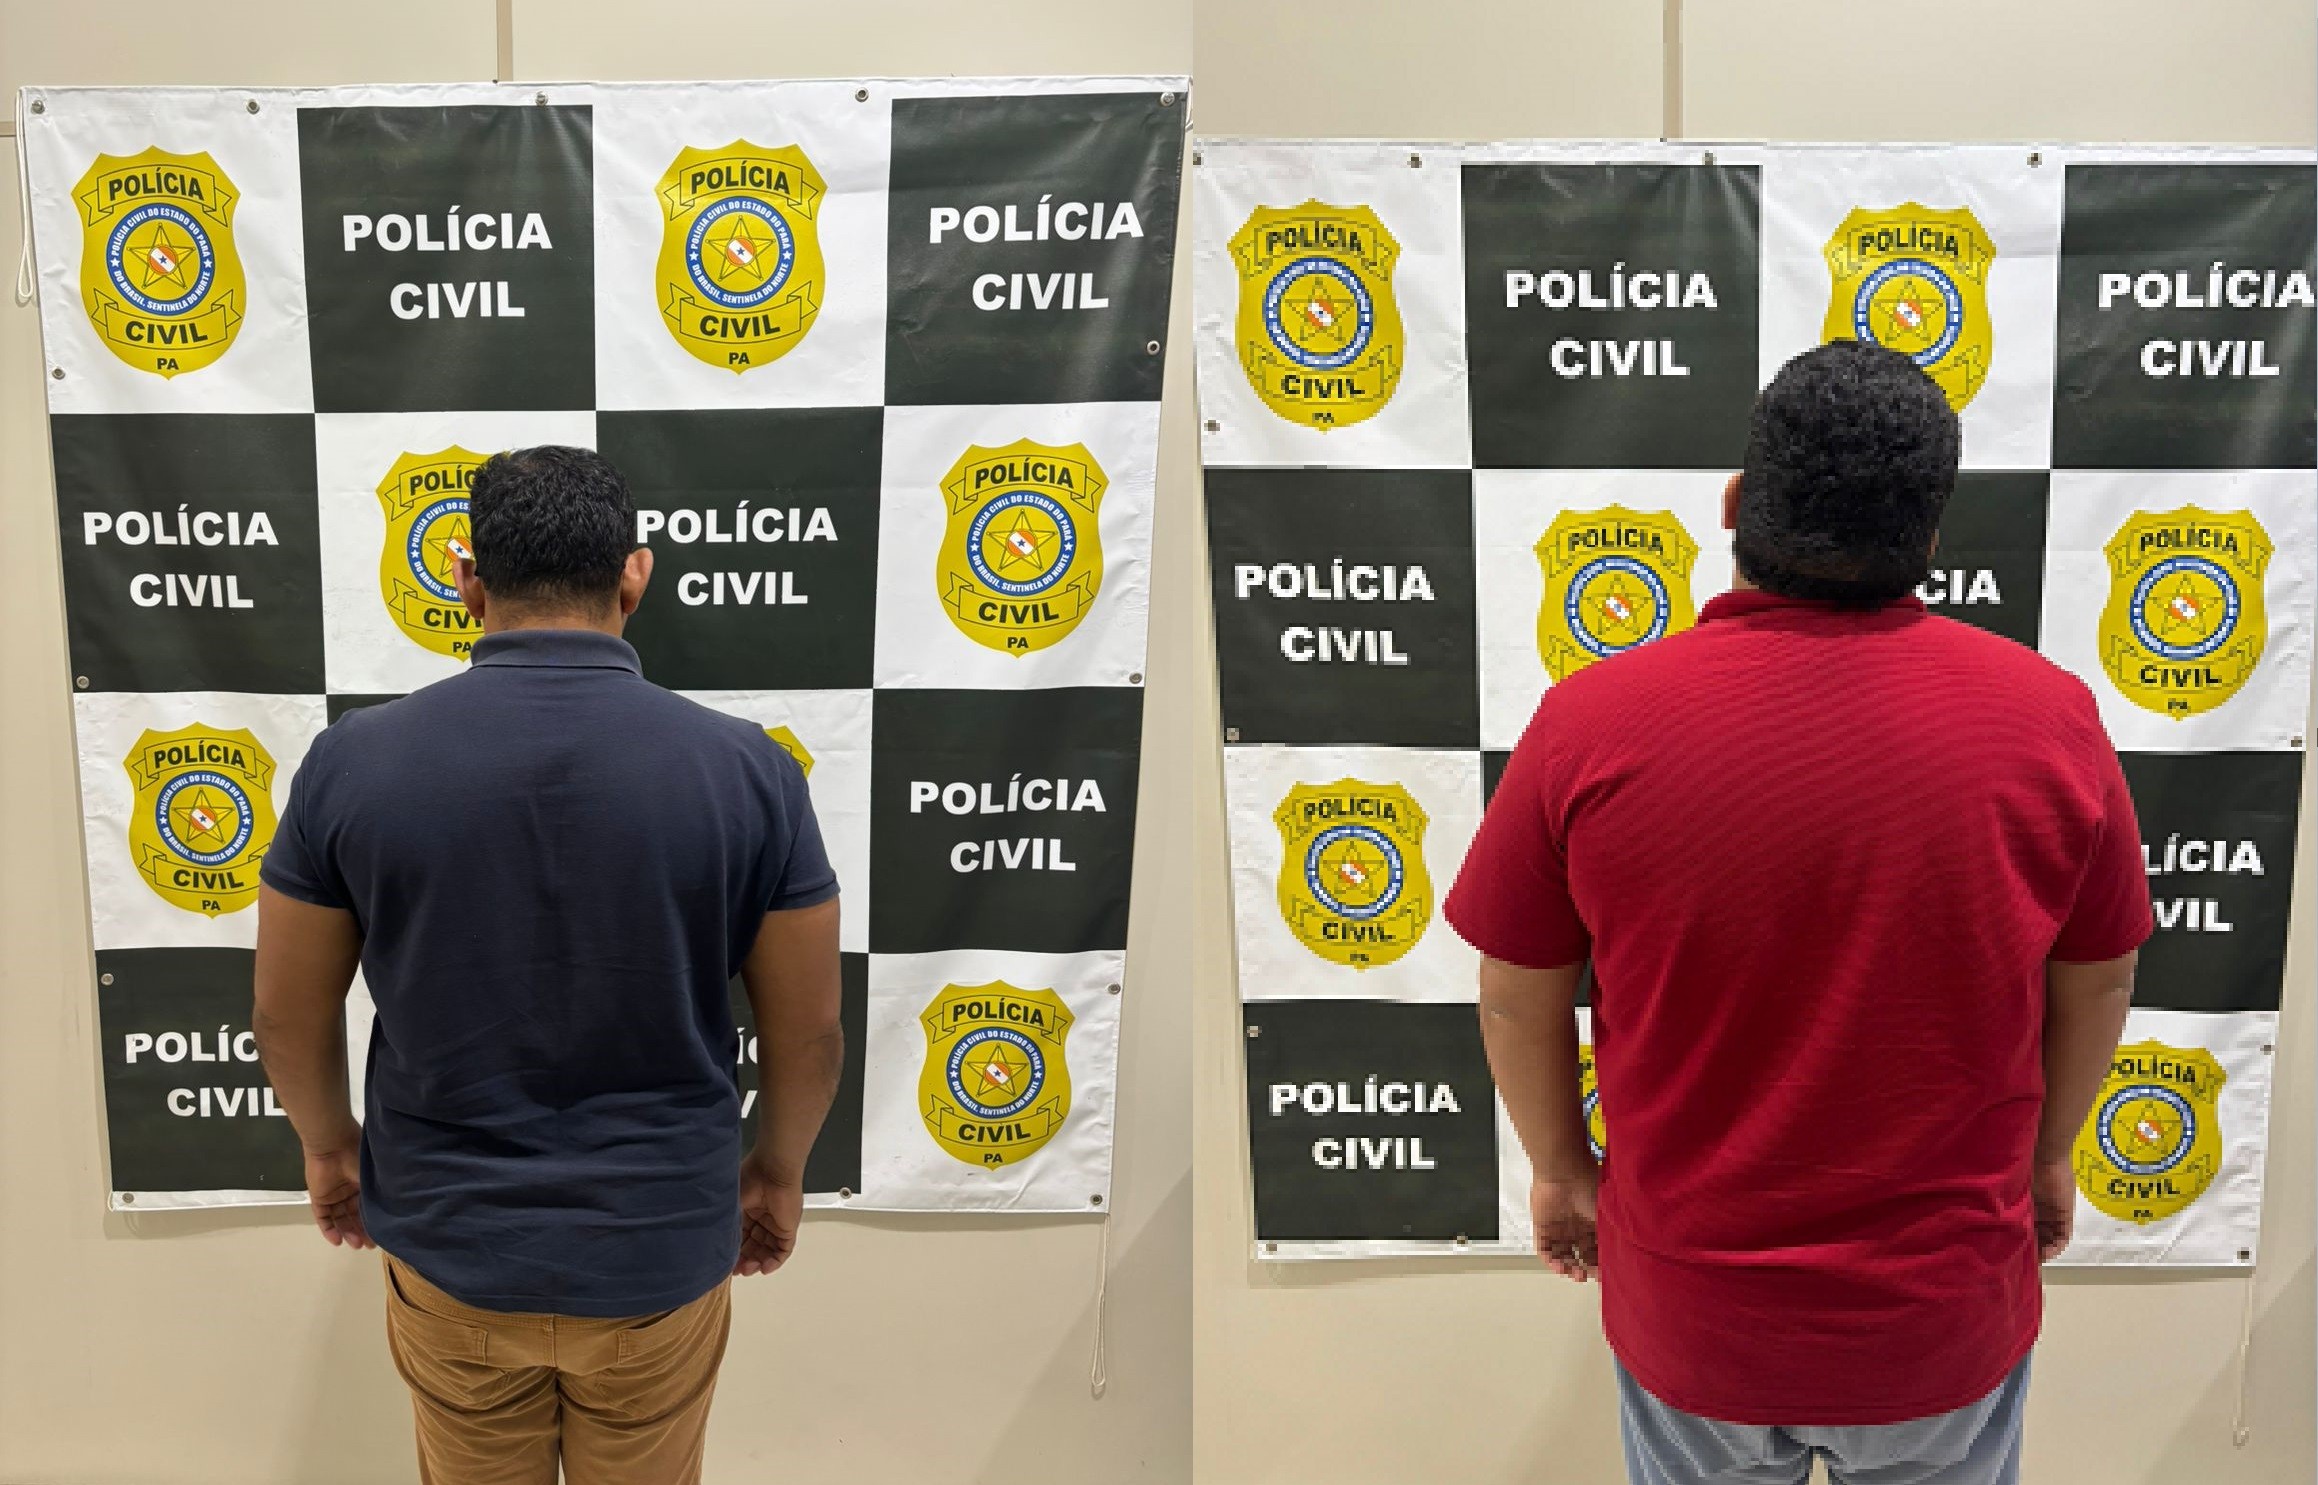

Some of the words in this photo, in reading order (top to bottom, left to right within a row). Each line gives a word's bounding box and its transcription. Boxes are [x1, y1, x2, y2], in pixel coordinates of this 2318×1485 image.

[108, 167, 205, 202] POLÍCIA
[691, 160, 790, 195] POLÍCIA
[111, 225, 130, 256] POLÍCIA
[127, 211, 147, 227] CIVIL
[147, 208, 159, 217] DO
[160, 208, 190, 225] ESTADO
[188, 222, 200, 235] DO
[343, 205, 552, 251] POLÍCIA
[691, 218, 710, 249] POLÍCIA
[707, 204, 730, 223] CIVIL
[728, 201, 740, 215] DO
[741, 201, 772, 220] ESTADO
[770, 215, 782, 228] DO
[930, 194, 1144, 243] POLÍCIA
[1266, 220, 1361, 251] POLÍCIA
[1858, 221, 1958, 256] POLÍCIA
[114, 270, 125, 282] DO
[147, 300, 189, 312] SENTINELA
[187, 293, 198, 304] DO
[194, 271, 210, 296] NORTE
[391, 281, 525, 319] CIVIL
[692, 264, 702, 276] DO
[722, 291, 763, 304] SENTINELA
[762, 284, 774, 296] DO
[770, 263, 789, 287] NORTE
[973, 273, 1109, 310] CIVIL
[1507, 262, 1717, 307] POLÍCIA
[2099, 262, 2314, 307] POLÍCIA
[125, 320, 208, 345] CIVIL
[699, 314, 781, 338] CIVIL
[156, 357, 179, 370] PA
[728, 352, 750, 365] PA
[1552, 341, 1690, 377] CIVIL
[2141, 341, 2279, 375] CIVIL
[1281, 374, 1365, 398] CIVIL
[410, 465, 476, 496] POLÍC
[975, 457, 1075, 489] POLÍCIA
[84, 504, 279, 545] POLÍCIA
[426, 504, 446, 521] CIVIL
[446, 501, 458, 510] DO
[637, 500, 838, 543] POLÍCIA
[972, 511, 991, 541] POLÍCIA
[989, 498, 1009, 513] CIVIL
[1010, 495, 1022, 503] DO
[1024, 495, 1055, 511] ESTADO
[1048, 508, 1064, 520] DO
[1568, 522, 1663, 555] POLÍCIA
[2140, 522, 2238, 551] POLÍCIA
[678, 572, 807, 605] CIVIL
[972, 555, 982, 566] DO
[1001, 581, 1043, 592] SENTINELA
[1042, 574, 1054, 585] DO
[1051, 554, 1069, 577] NORTE
[1235, 559, 1434, 600] POLÍCIA
[130, 574, 253, 608] CIVIL
[978, 602, 1060, 624] CIVIL
[1007, 637, 1029, 648] PA
[1281, 627, 1407, 665] CIVIL
[2139, 665, 2222, 687] CIVIL
[154, 740, 246, 769] POLÍCIA
[911, 773, 1106, 814] POLÍCIA
[951, 838, 1075, 872] CIVIL
[2141, 832, 2265, 876] LÍCIA
[173, 869, 244, 890] CIVIL
[202, 900, 221, 911] PA
[2153, 898, 2234, 931] VIL
[1322, 923, 1396, 942] CIVIL
[952, 997, 1044, 1027] POLÍCIA
[125, 1025, 259, 1063] POLÍC
[1269, 1074, 1461, 1116] POLÍCIA
[958, 1123, 1031, 1143] CIVIL
[984, 1154, 1003, 1163] PA
[1312, 1138, 1434, 1169] CIVIL
[2107, 1179, 2180, 1198] CIVIL
